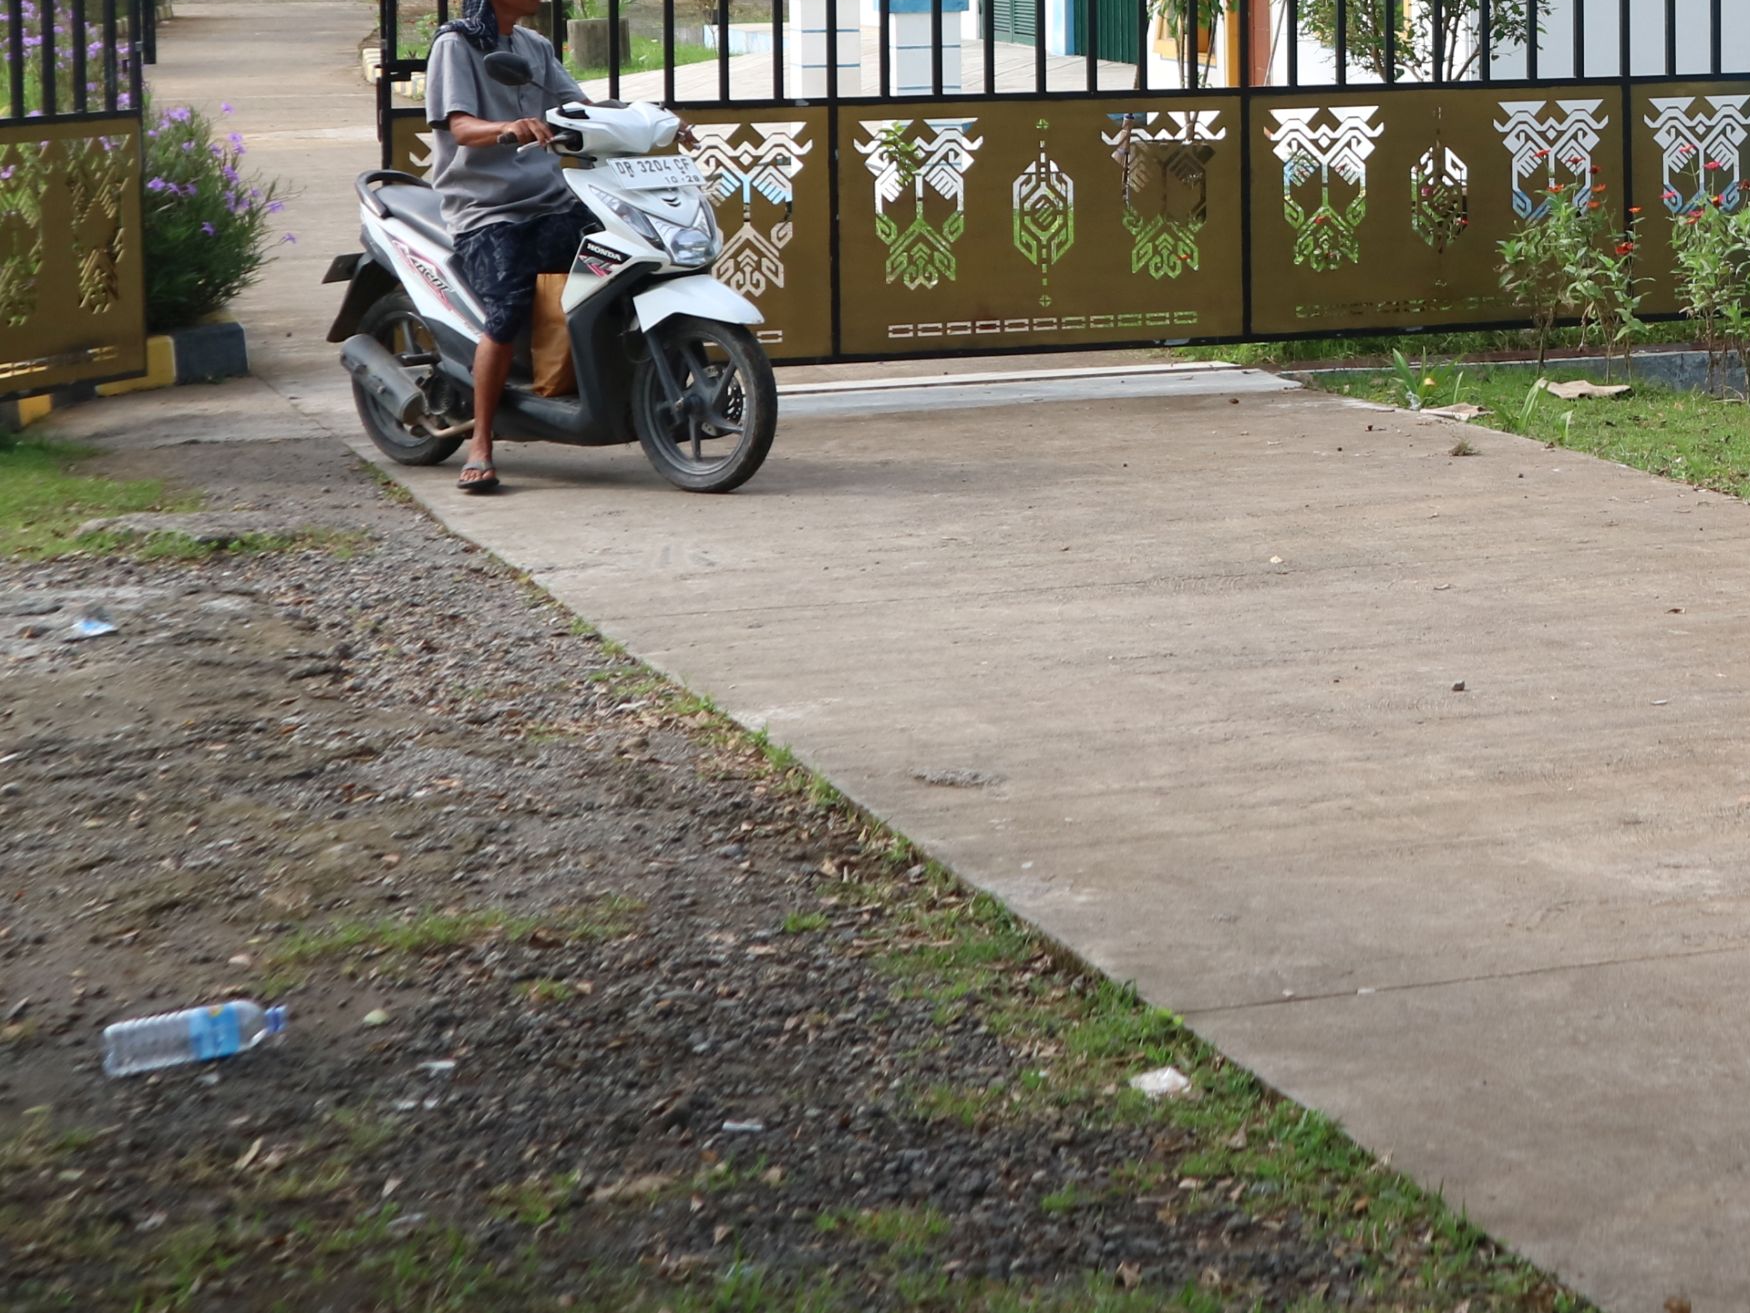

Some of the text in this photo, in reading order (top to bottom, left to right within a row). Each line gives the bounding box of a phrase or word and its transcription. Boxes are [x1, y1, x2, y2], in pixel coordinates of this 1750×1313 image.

[615, 158, 690, 175] DR 3204 CF
[586, 243, 622, 261] HONDA
